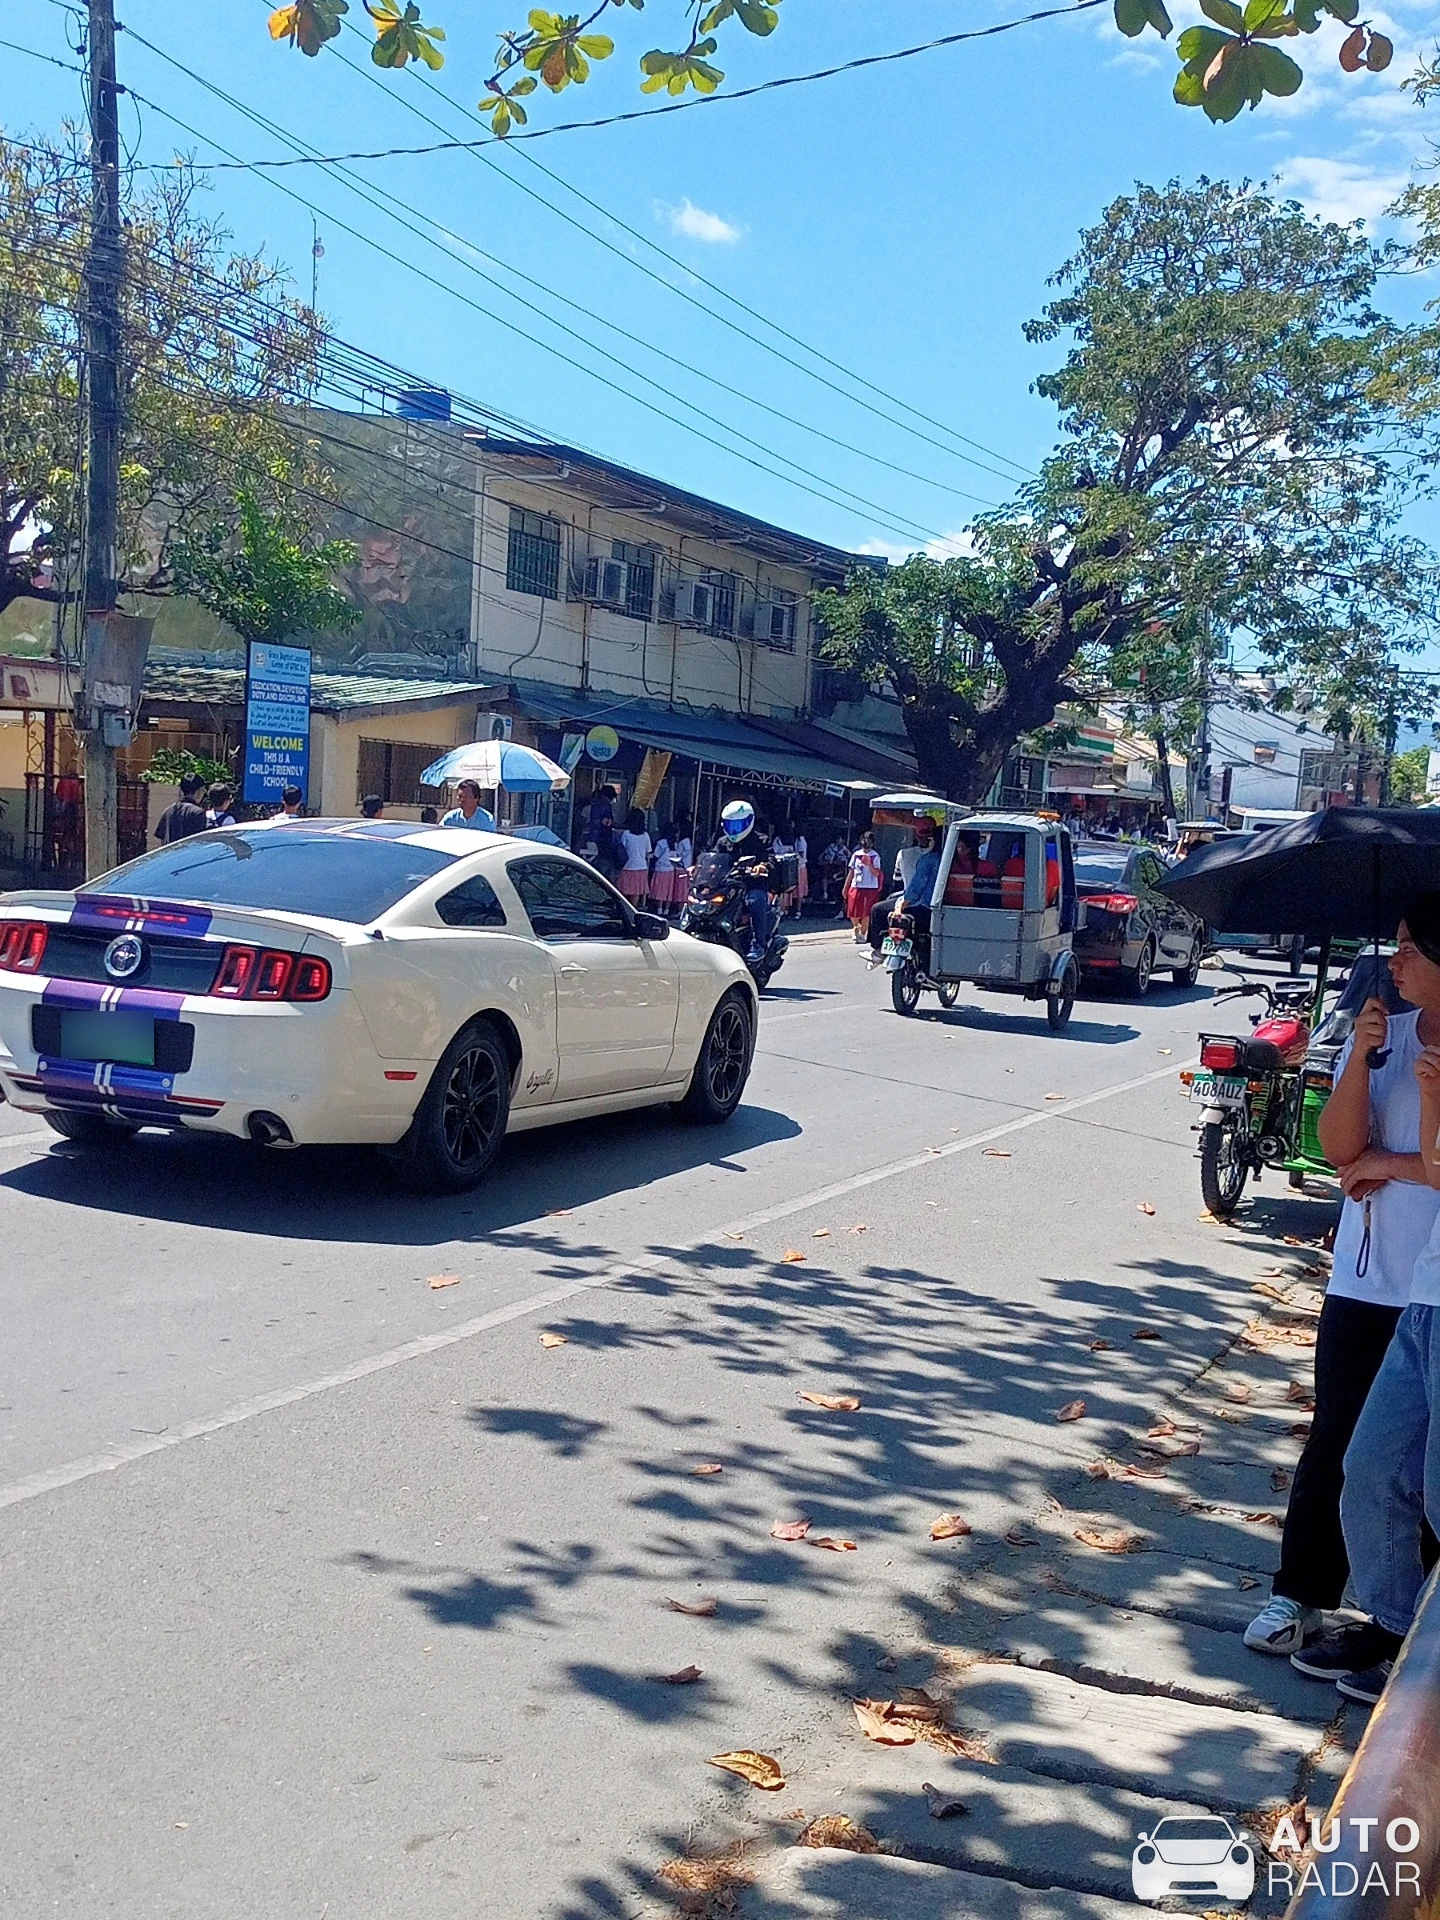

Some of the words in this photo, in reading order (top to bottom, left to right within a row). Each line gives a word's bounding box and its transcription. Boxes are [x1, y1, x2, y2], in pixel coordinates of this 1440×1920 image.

[279, 693, 306, 704] DISCIPLINE
[252, 734, 304, 751] WELCOME
[264, 752, 277, 763] THIS
[278, 752, 284, 763] IS
[285, 753, 290, 764] A
[249, 763, 304, 776] CHILD-FRIENDLY
[263, 776, 288, 787] SCHOOL
[1193, 1081, 1243, 1100] 408AUZ
